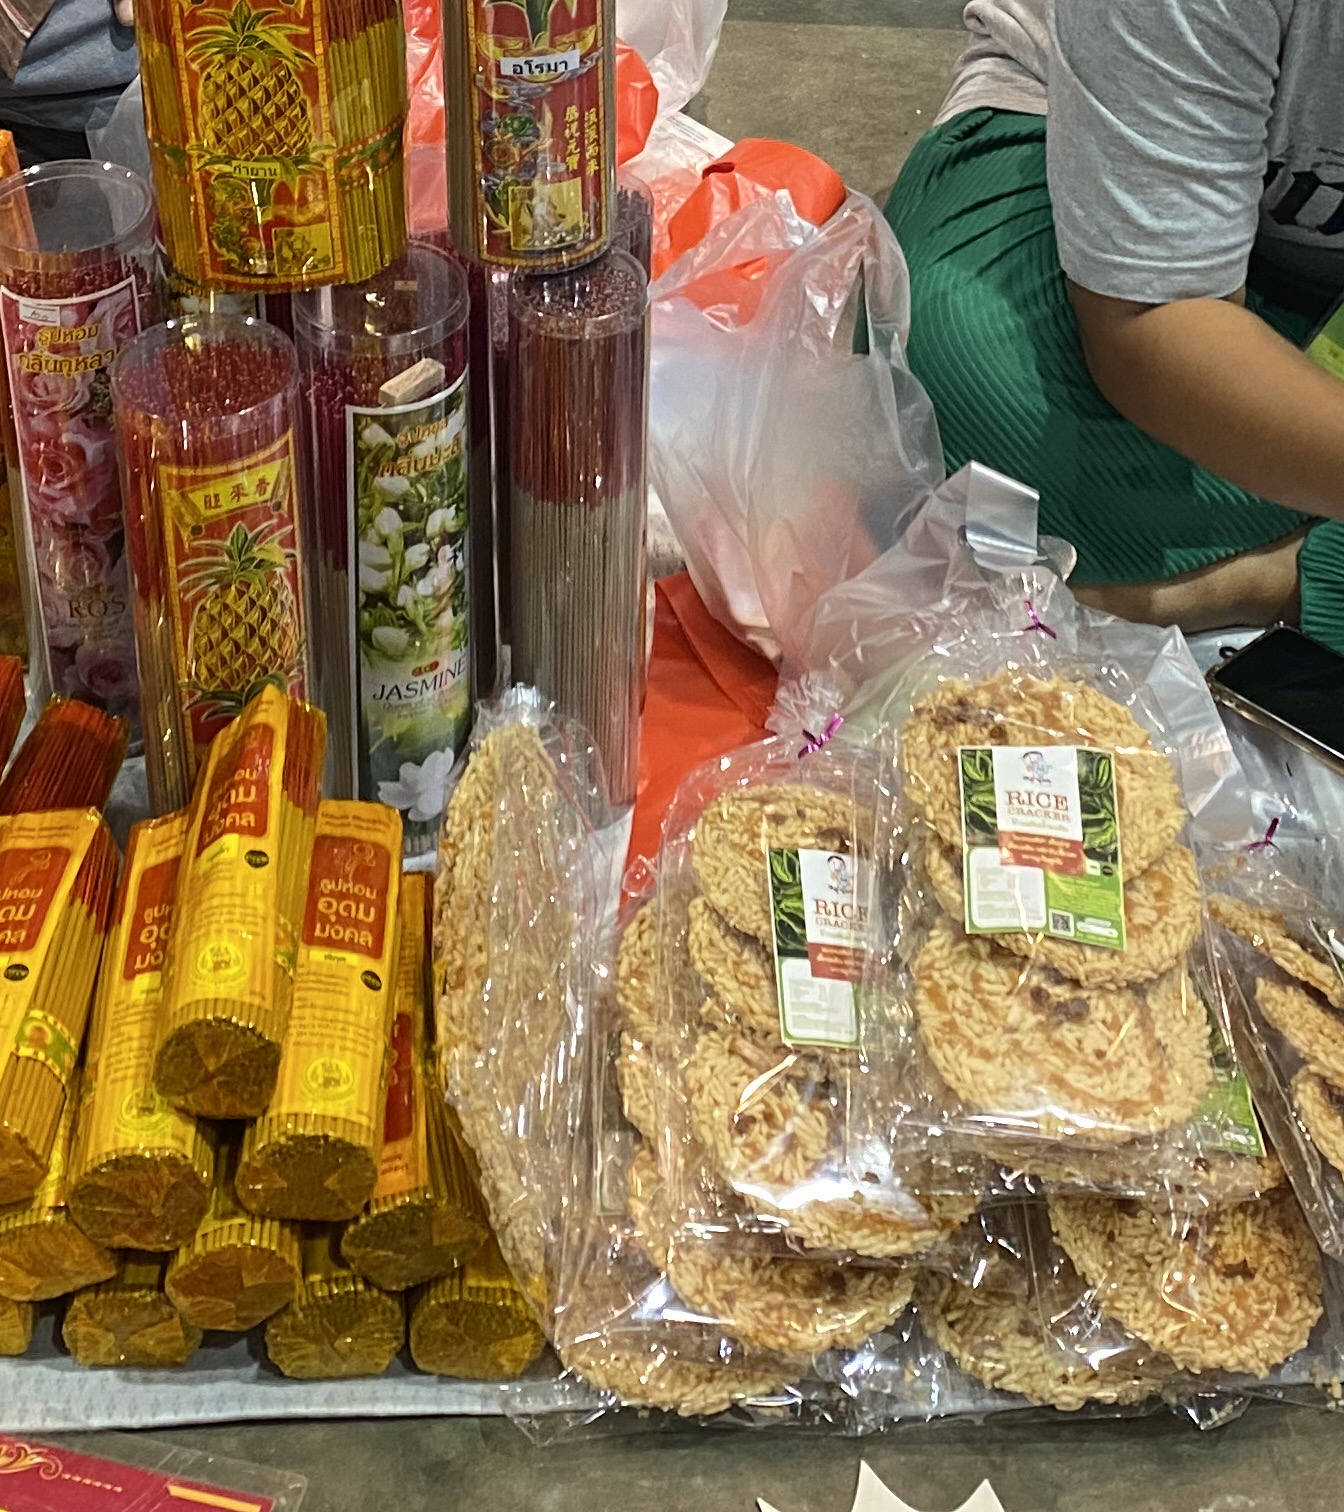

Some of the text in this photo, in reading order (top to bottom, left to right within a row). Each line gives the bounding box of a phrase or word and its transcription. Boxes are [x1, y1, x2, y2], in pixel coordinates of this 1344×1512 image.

[512, 60, 568, 75] อโรมา
[36, 324, 100, 346] ธูปหอม
[17, 345, 121, 377] กลิ่นกุหลา
[67, 596, 126, 621] ROS
[373, 657, 467, 701] JASMINE
[1006, 790, 1069, 812] RICE
[320, 878, 377, 900] ธูปหอม
[317, 896, 376, 924] อุดม
[314, 922, 373, 949] มงคล
